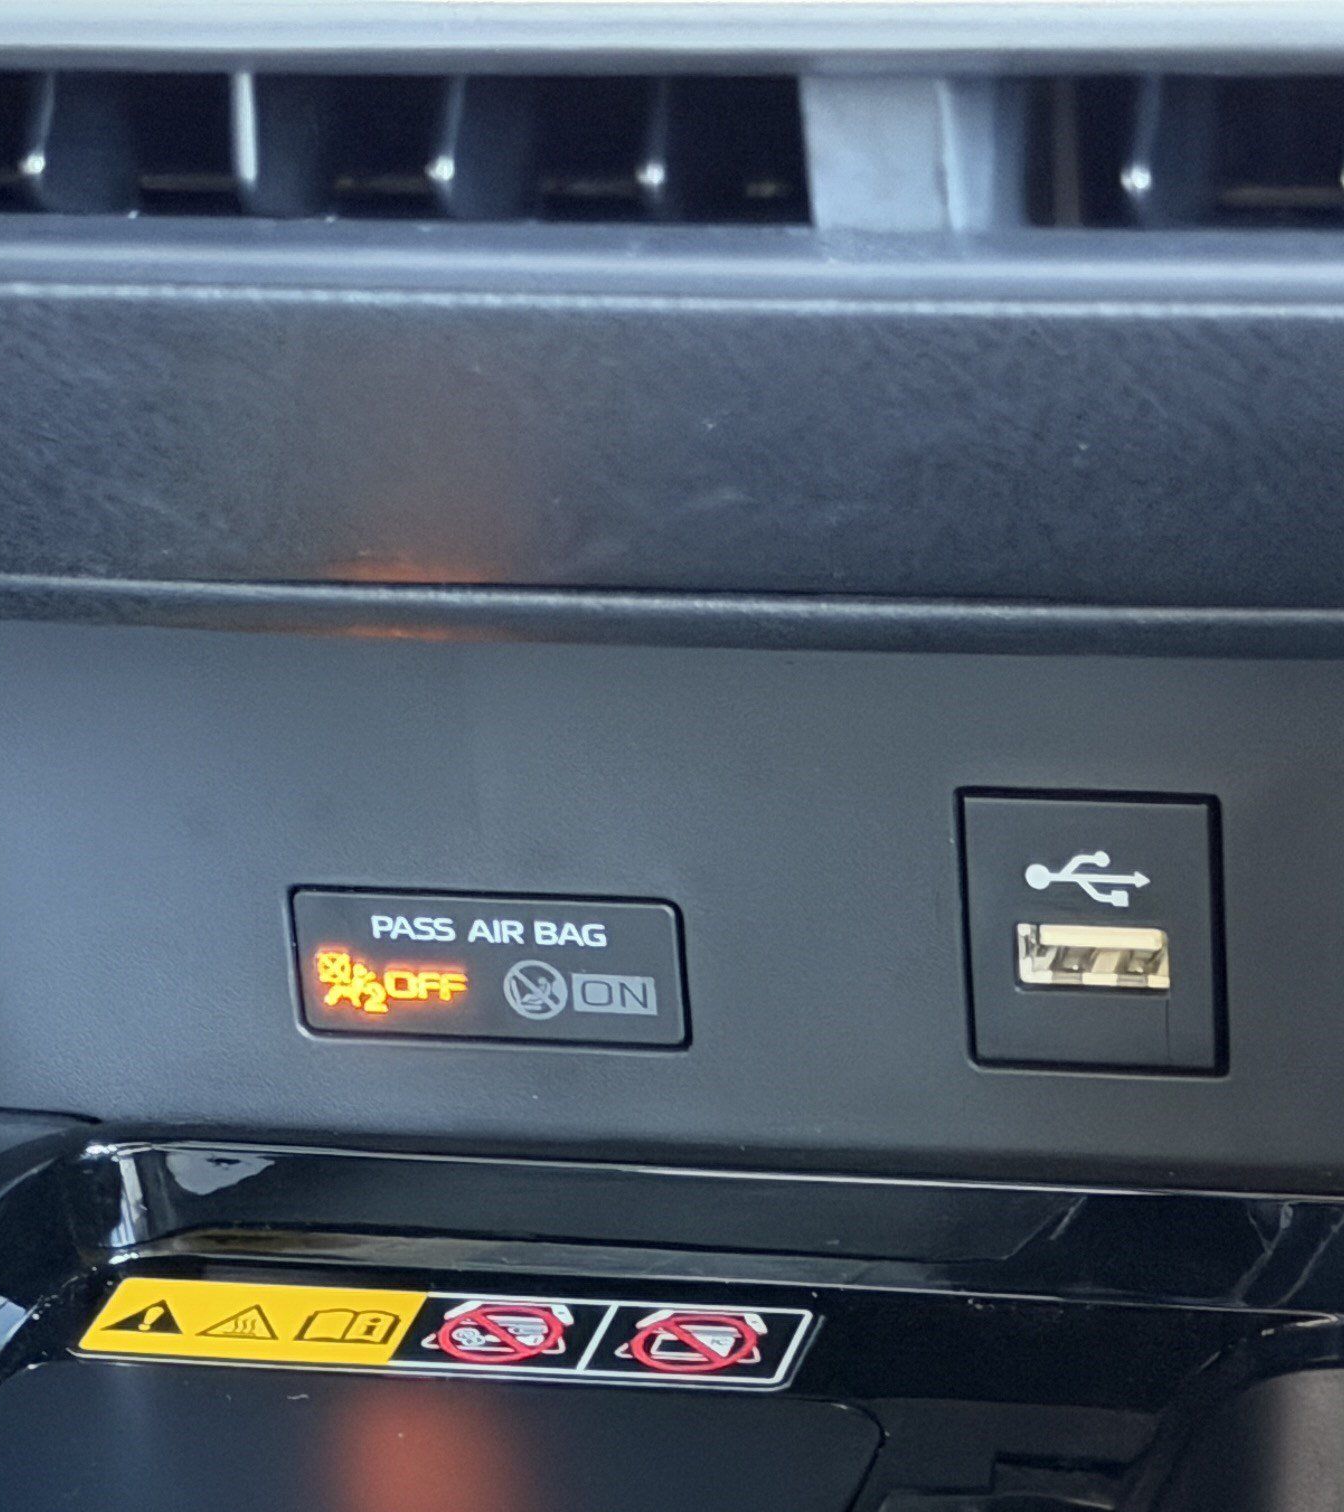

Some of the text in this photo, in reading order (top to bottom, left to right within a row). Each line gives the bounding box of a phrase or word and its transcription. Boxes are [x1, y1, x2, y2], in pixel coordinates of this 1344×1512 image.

[371, 915, 608, 947] PASS AIR BAG
[383, 970, 468, 1001] OFF
[581, 981, 649, 1009] ON
